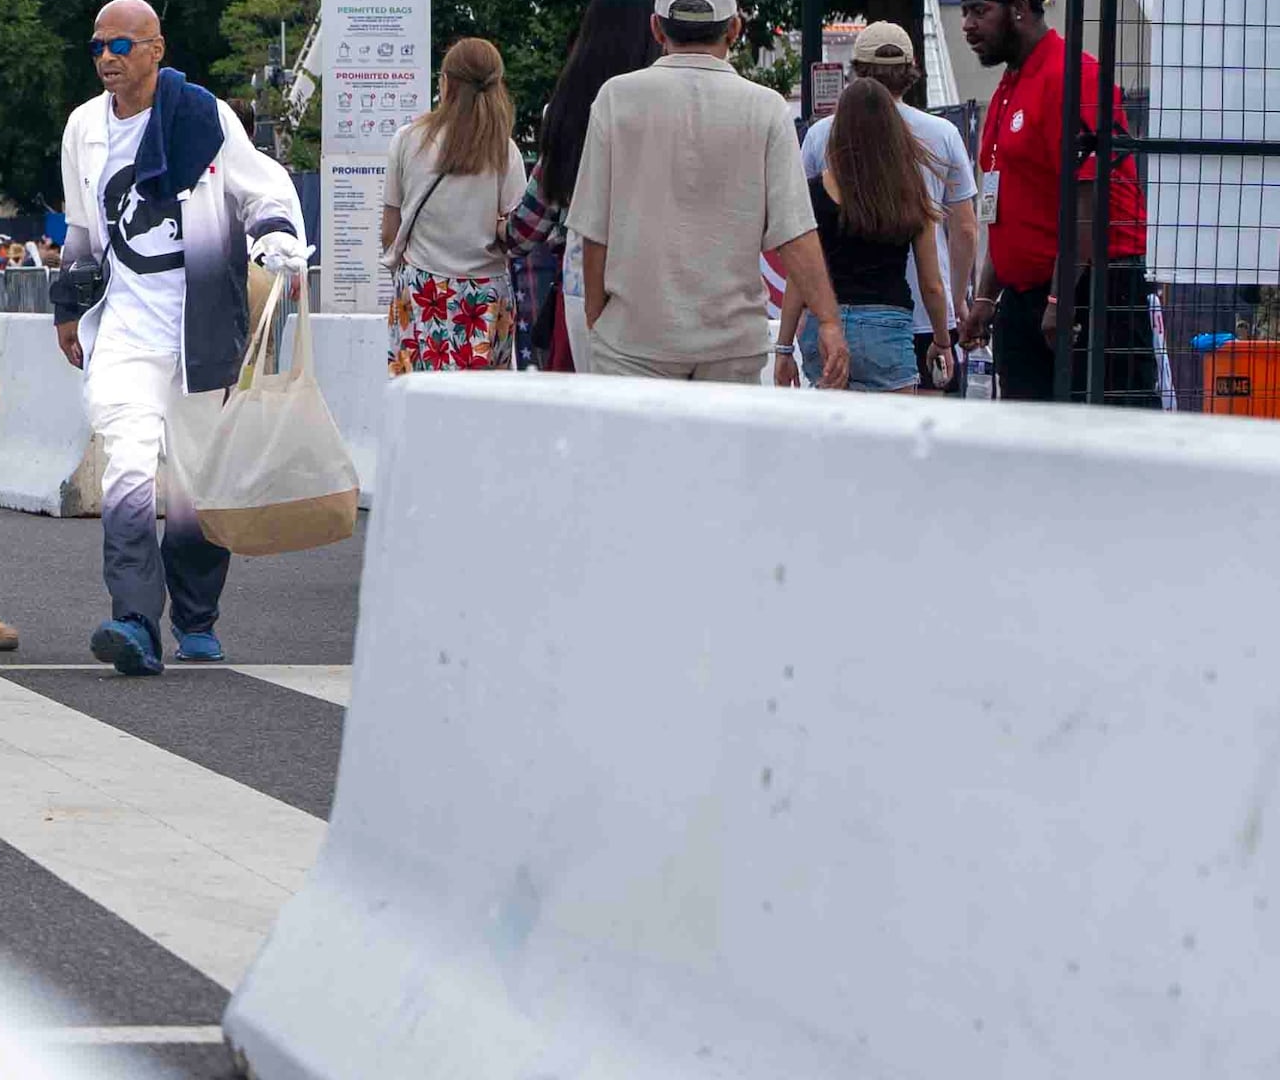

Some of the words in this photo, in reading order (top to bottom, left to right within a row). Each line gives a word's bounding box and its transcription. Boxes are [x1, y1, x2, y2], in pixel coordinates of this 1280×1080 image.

[337, 6, 387, 14] PERMITTED
[389, 6, 413, 14] BAGS
[336, 72, 390, 80] PROHIBITED
[391, 72, 415, 80] BAGS
